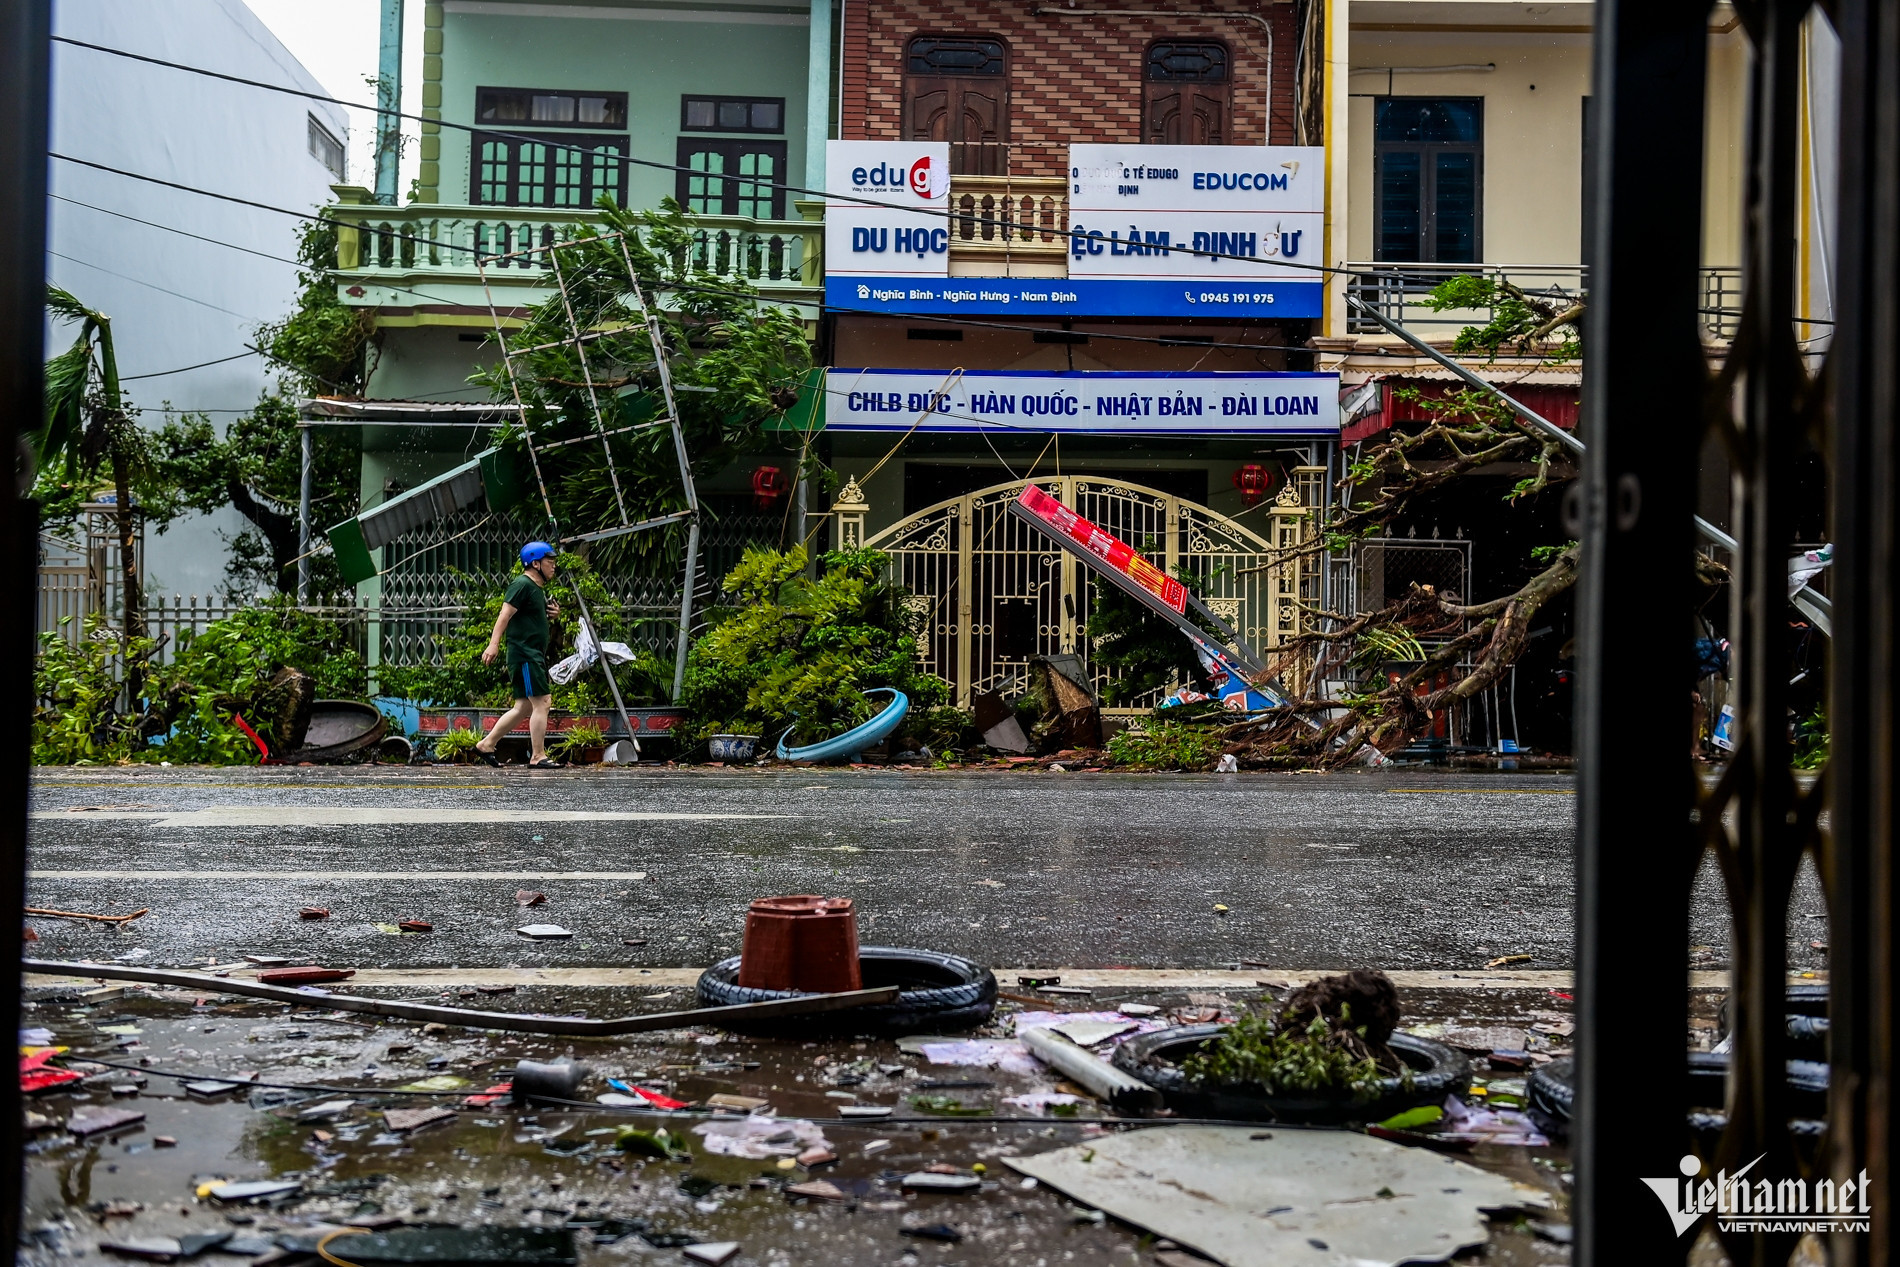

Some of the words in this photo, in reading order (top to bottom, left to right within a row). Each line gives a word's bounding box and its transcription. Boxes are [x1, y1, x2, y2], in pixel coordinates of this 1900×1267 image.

[1147, 168, 1179, 180] EDUGO
[1193, 172, 1288, 191] EDUCOM
[1118, 184, 1140, 197] ĐỊNH
[852, 227, 888, 253] DU
[895, 227, 948, 259] HỌC
[1111, 224, 1170, 257] LÀM
[1192, 231, 1256, 262] ĐỊNH
[872, 289, 906, 302] Nghĩa
[910, 289, 934, 300] Bình
[943, 290, 977, 303] Nghĩa
[980, 291, 1010, 304] Hưng
[1021, 292, 1048, 302] Nam
[1051, 292, 1078, 304] Định
[1200, 292, 1230, 303] 0945
[1232, 293, 1250, 304] 191
[1252, 294, 1275, 304] 975
[848, 391, 903, 413] CHLB
[907, 389, 952, 413] ĐỨC
[971, 390, 1018, 414] HÀN
[1021, 388, 1078, 416] QUỐC
[1097, 392, 1153, 420] NHẬT
[1158, 389, 1202, 416] BẢN
[1222, 392, 1258, 416] ĐÀI
[1264, 395, 1319, 416] LOAN
